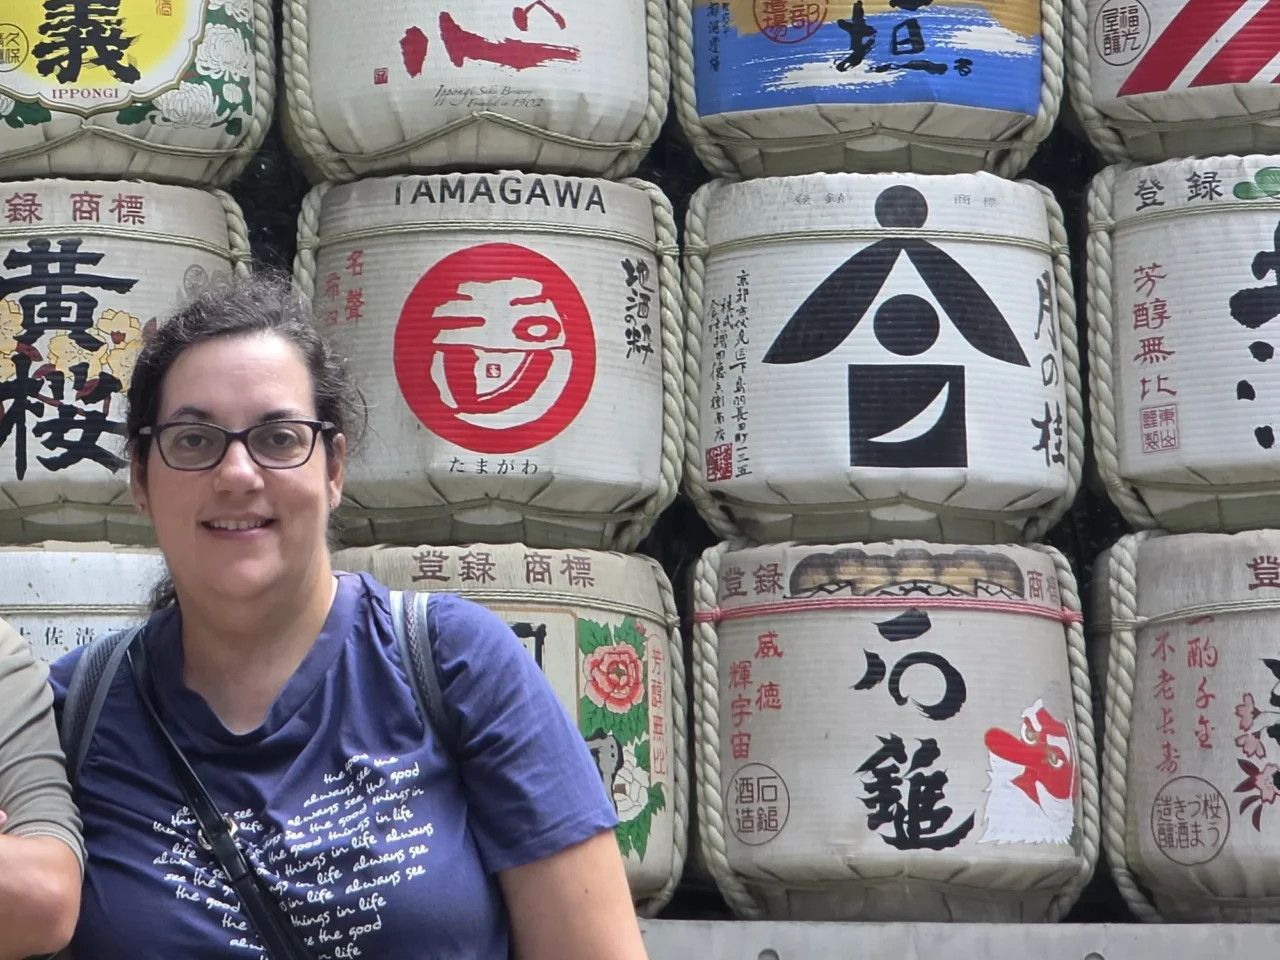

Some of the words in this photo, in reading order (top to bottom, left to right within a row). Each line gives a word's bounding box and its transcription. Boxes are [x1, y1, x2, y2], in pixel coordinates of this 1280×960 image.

[51, 86, 119, 100] IPPONGI
[1134, 171, 1223, 212] 登録
[1133, 262, 1178, 401] 芳醇無比
[448, 457, 539, 477] たまがわ
[411, 550, 596, 589] 登録商標
[721, 563, 785, 600] 登録
[287, 803, 338, 826] always
[345, 795, 364, 809] see
[366, 778, 385, 795] the
[391, 762, 420, 784] good
[304, 782, 354, 807] always
[310, 821, 333, 833] the
[339, 804, 367, 827] good
[372, 788, 409, 804] things
[172, 842, 197, 859] life
[268, 849, 287, 865] the
[290, 836, 322, 858] good
[329, 816, 370, 840] things
[375, 812, 391, 823] in
[393, 804, 414, 822] life
[285, 852, 326, 878] things
[331, 846, 349, 858] in
[351, 831, 378, 849] life
[385, 823, 434, 844] always
[317, 866, 343, 885] life
[352, 848, 405, 872] always
[409, 844, 429, 858] see
[175, 884, 200, 901] the
[206, 897, 241, 913] good
[288, 898, 304, 909] in
[307, 889, 334, 904] life
[345, 870, 401, 895] always
[405, 865, 426, 881] see
[221, 913, 248, 930] the
[290, 911, 331, 928] things
[336, 905, 355, 918] in
[358, 892, 387, 912] life
[318, 929, 343, 942] the
[348, 914, 382, 941] good
[334, 942, 362, 958] life
